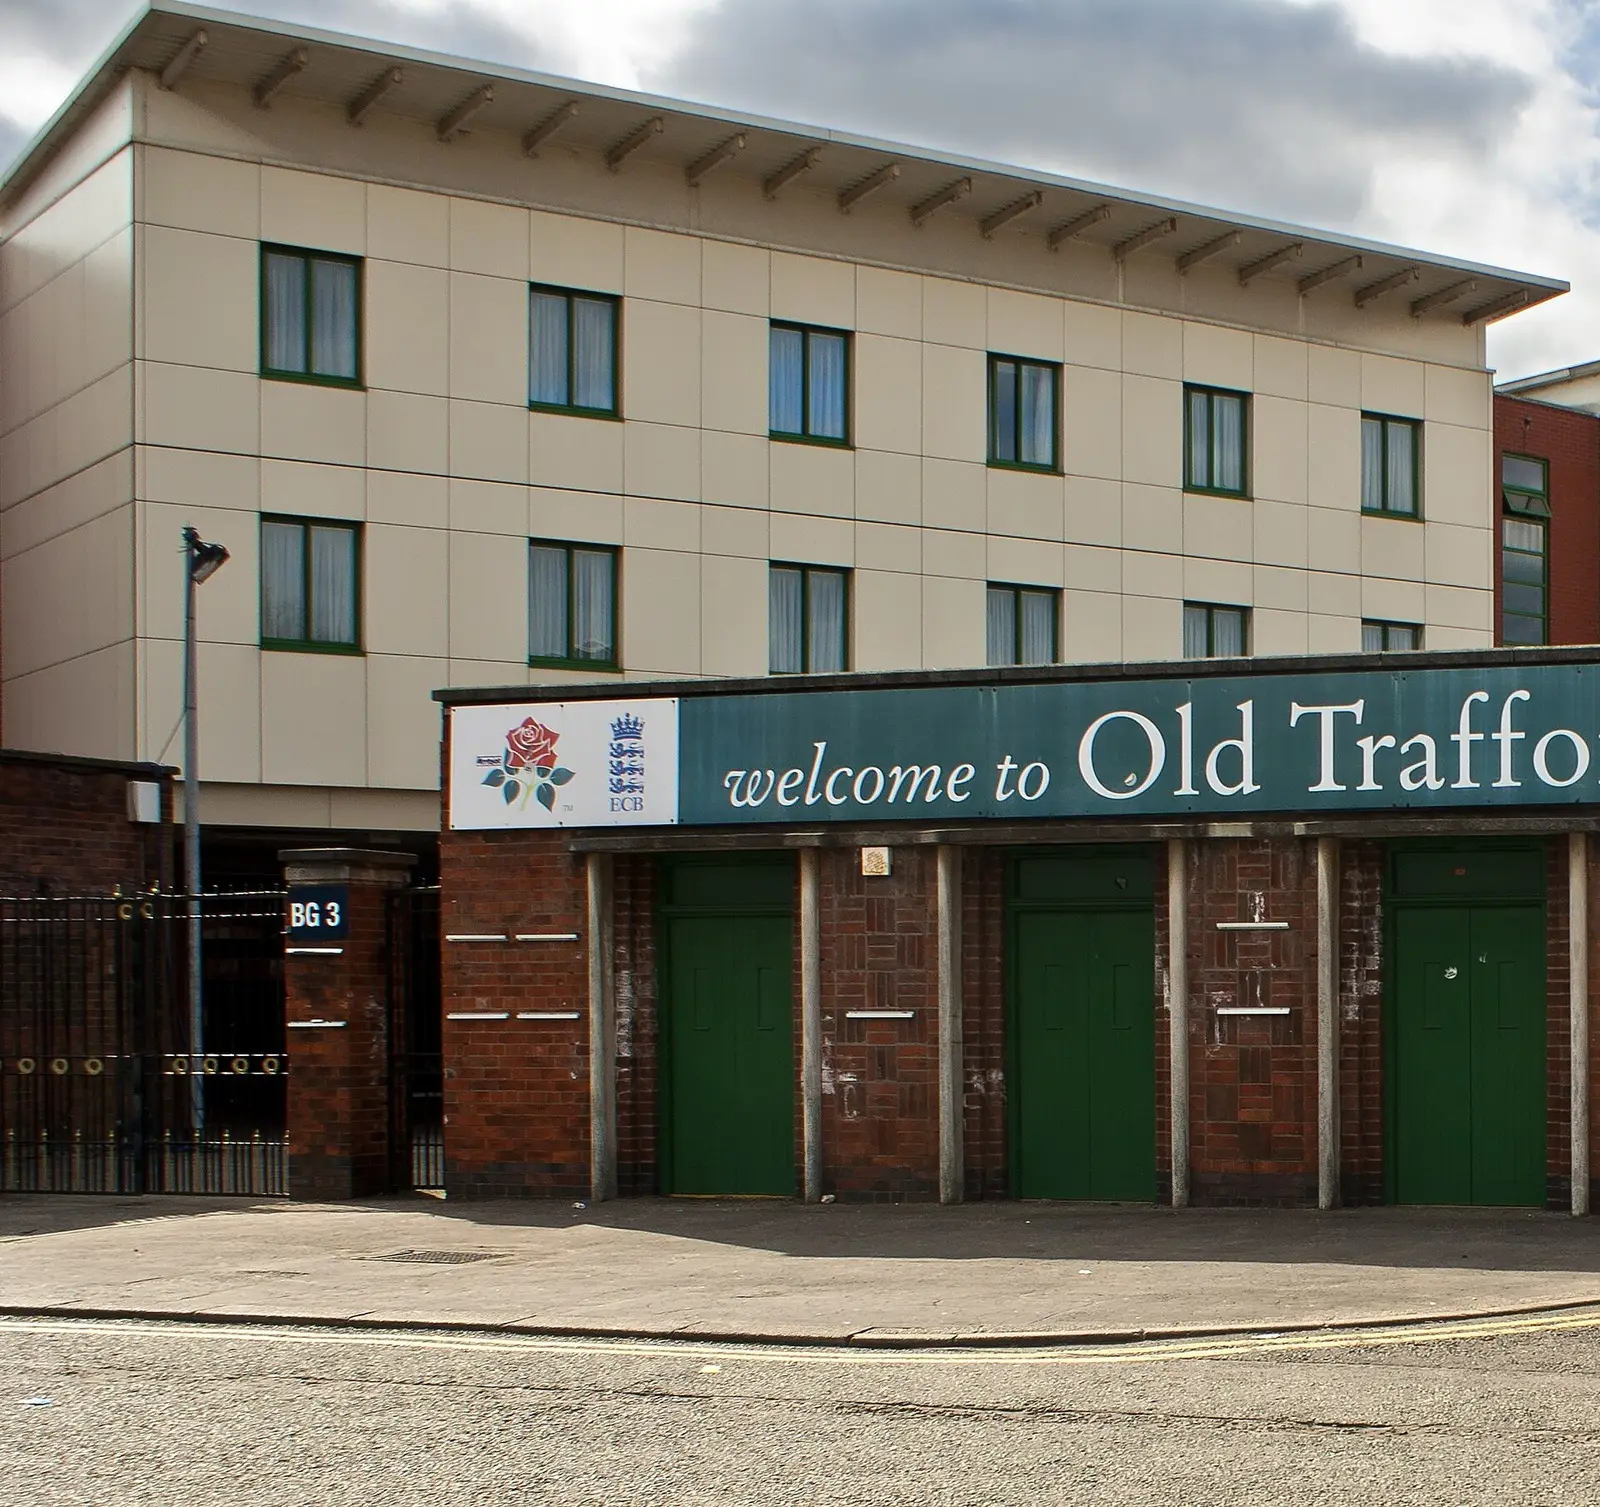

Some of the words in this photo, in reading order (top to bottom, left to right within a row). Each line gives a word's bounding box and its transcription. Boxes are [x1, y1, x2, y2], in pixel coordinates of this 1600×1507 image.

[724, 741, 976, 808] welcome
[995, 755, 1051, 802] to
[1077, 699, 1261, 800] Old
[610, 796, 644, 812] ECB
[290, 901, 320, 928] BG
[325, 901, 341, 927] 3
